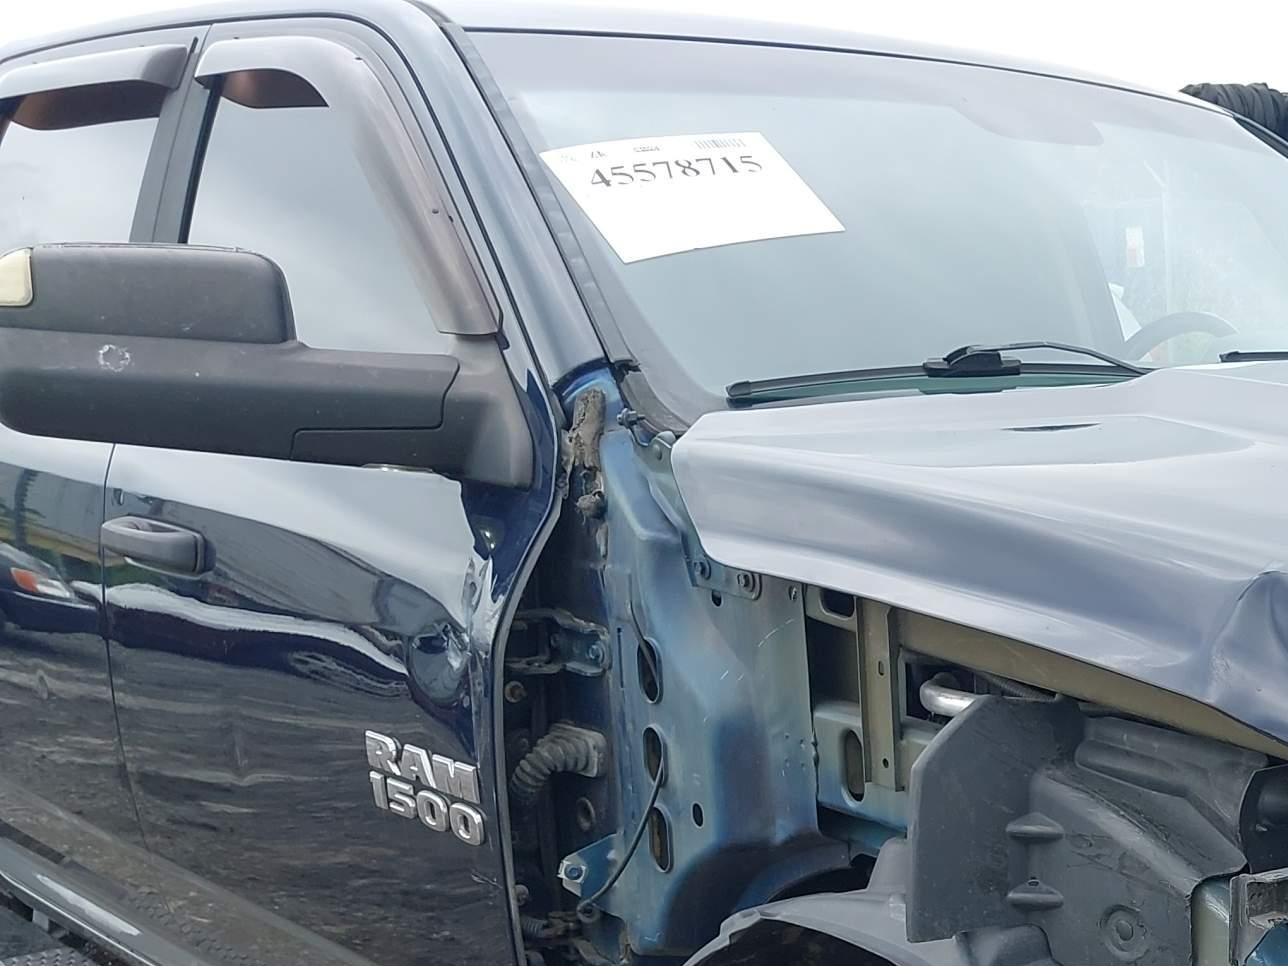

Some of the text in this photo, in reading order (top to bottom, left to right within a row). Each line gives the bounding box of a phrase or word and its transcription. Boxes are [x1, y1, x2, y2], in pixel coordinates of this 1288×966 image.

[591, 155, 762, 187] 45578715
[365, 729, 480, 804] RAM
[369, 770, 486, 846] 1500
